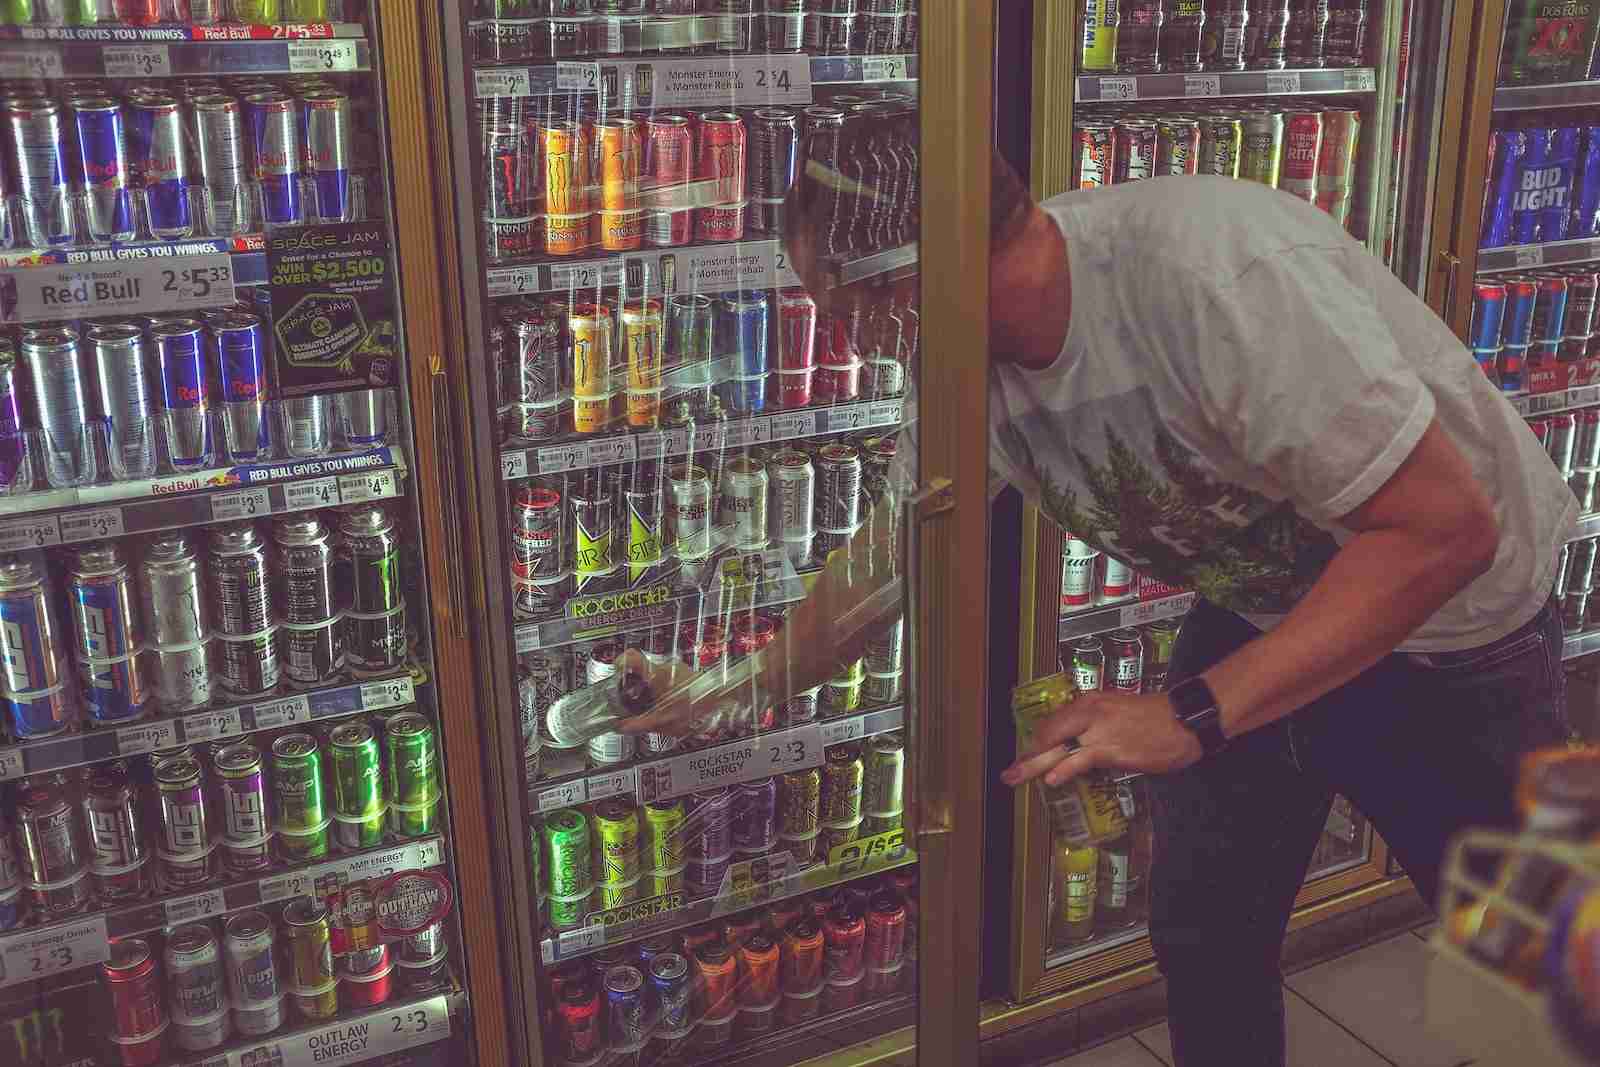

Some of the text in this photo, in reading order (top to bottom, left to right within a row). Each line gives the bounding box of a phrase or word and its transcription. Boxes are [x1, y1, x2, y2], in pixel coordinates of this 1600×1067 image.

[1543, 6, 1561, 17] DOS
[48, 28, 75, 40] BULL
[76, 28, 111, 40] GIVES
[112, 27, 138, 40] YOU
[204, 30, 228, 40] Red
[230, 27, 251, 40] Bull
[1085, 0, 1097, 48] TWISTE
[673, 81, 711, 91] Monster
[756, 69, 792, 92] 2 $4
[1521, 168, 1561, 190] BUD
[1513, 186, 1567, 210] LIGHT
[272, 230, 380, 250] SPACE JAM
[67, 252, 88, 264] RED
[91, 250, 115, 263] BULL
[117, 247, 148, 261] GIVES
[149, 245, 173, 258] YOU
[776, 254, 785, 270] 2
[272, 273, 314, 285] OVER
[278, 263, 304, 274] WIN
[312, 257, 384, 279] $2,500
[41, 278, 141, 304] Red Bull
[161, 270, 178, 292] 2
[249, 470, 268, 481] RED
[271, 468, 292, 479] BULL
[294, 464, 321, 475] GIVES
[323, 461, 342, 473] YOU
[152, 480, 199, 495] Red Bull
[575, 584, 672, 617] ROCKSTAR
[689, 747, 752, 770] ROCKSTAR
[770, 741, 805, 763] 2 $3
[699, 761, 745, 778] ENERGY
[391, 1010, 428, 1033] 2 $3
[308, 1023, 369, 1049] OUTLAW
[313, 1037, 369, 1062] ENERGY
